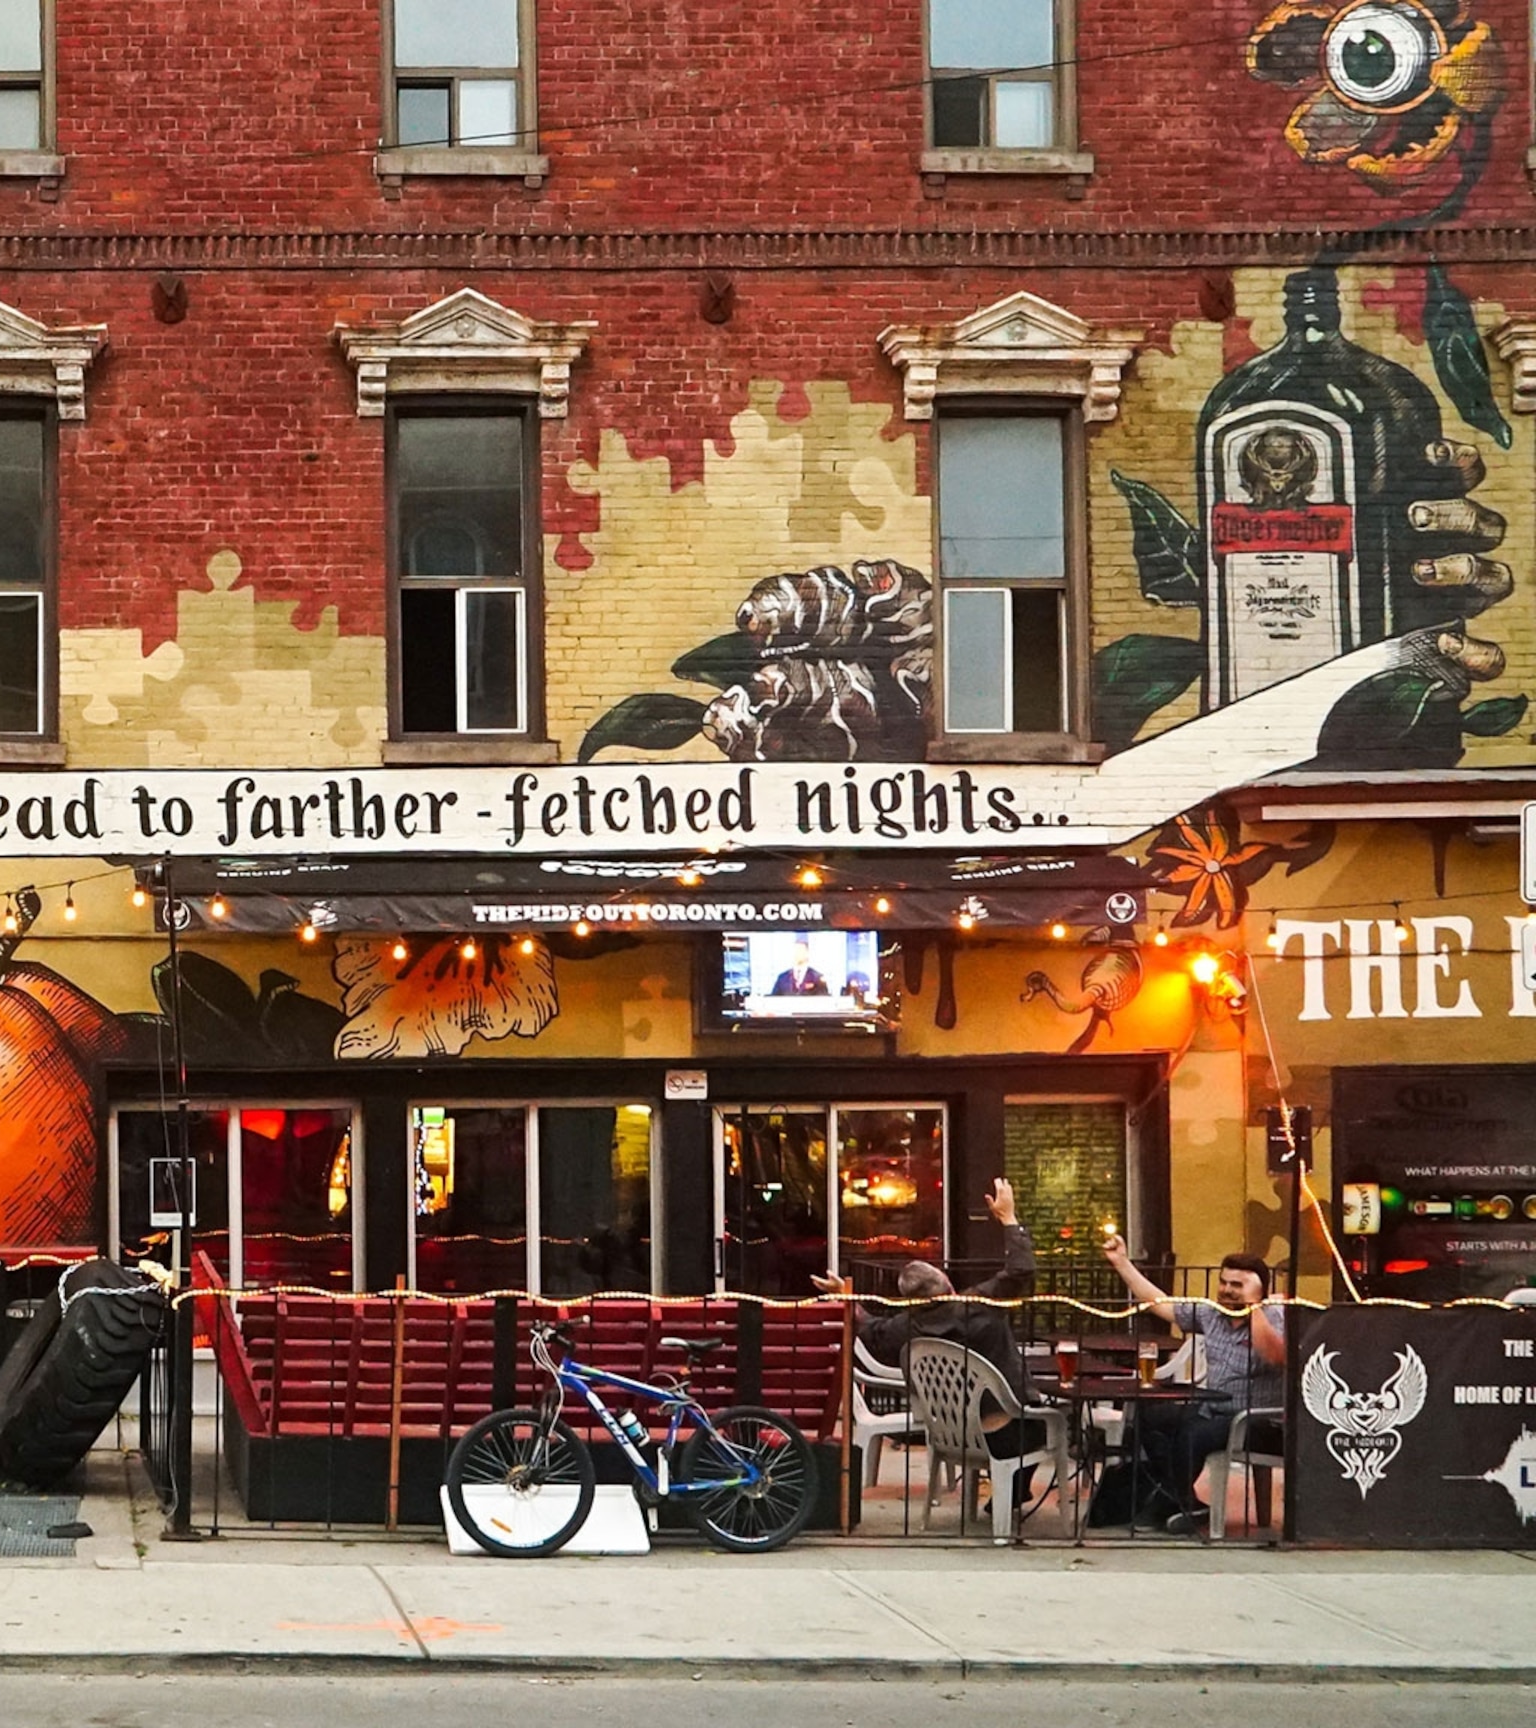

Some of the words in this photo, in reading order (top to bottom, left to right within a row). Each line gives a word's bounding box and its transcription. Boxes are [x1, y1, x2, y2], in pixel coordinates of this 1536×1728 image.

[132, 785, 193, 838] to
[218, 776, 458, 847] farther
[505, 768, 758, 847] fetched
[1274, 915, 1483, 1021] THE
[1404, 1165, 1437, 1177] WHAT
[1439, 1165, 1491, 1177] HAPPENS
[1492, 1165, 1507, 1176] AT
[1507, 1165, 1531, 1176] THE
[1446, 1240, 1488, 1252] STARTS
[1488, 1240, 1519, 1251] WITH
[1502, 1339, 1534, 1358] THE
[1454, 1386, 1500, 1404] HOME
[1501, 1386, 1523, 1404] OF
